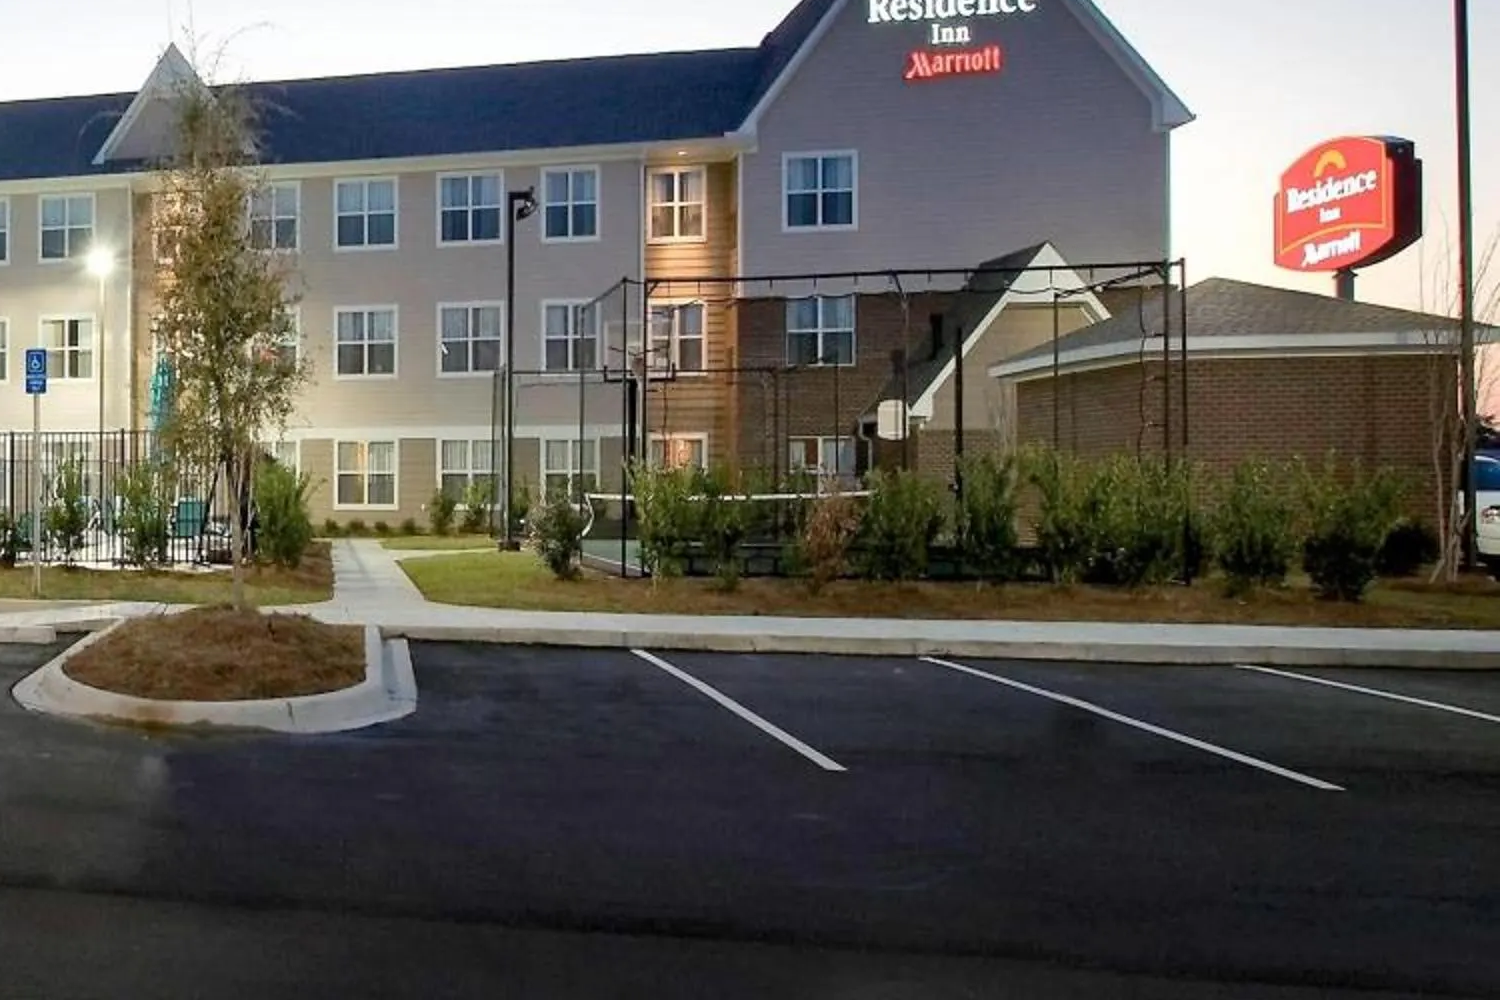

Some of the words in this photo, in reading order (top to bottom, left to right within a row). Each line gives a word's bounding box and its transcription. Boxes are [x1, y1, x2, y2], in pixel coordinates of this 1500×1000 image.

[931, 23, 971, 44] Inn
[903, 45, 1002, 80] Marriott
[1287, 169, 1377, 213] Residence
